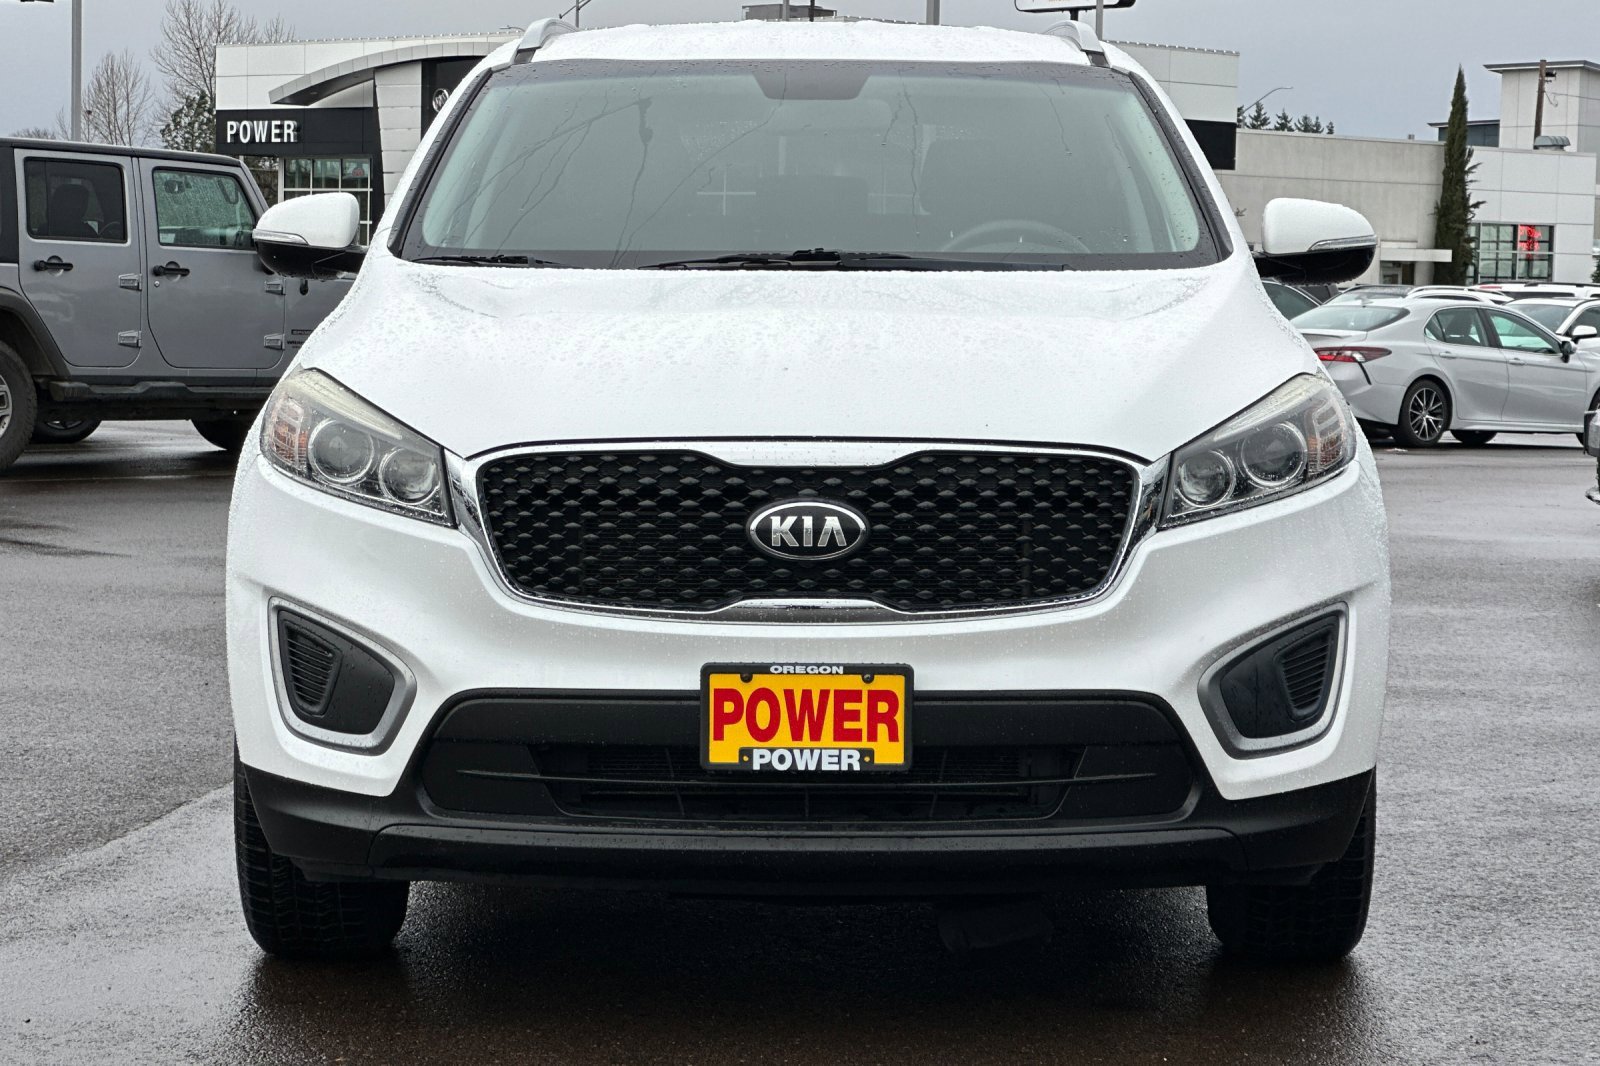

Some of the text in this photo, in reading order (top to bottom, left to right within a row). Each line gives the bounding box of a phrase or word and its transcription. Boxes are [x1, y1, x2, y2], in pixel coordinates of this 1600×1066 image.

[226, 120, 297, 143] POWER
[770, 515, 847, 547] KIA
[770, 665, 844, 674] OREGON
[713, 687, 900, 742] POWER
[752, 748, 861, 771] POWER
